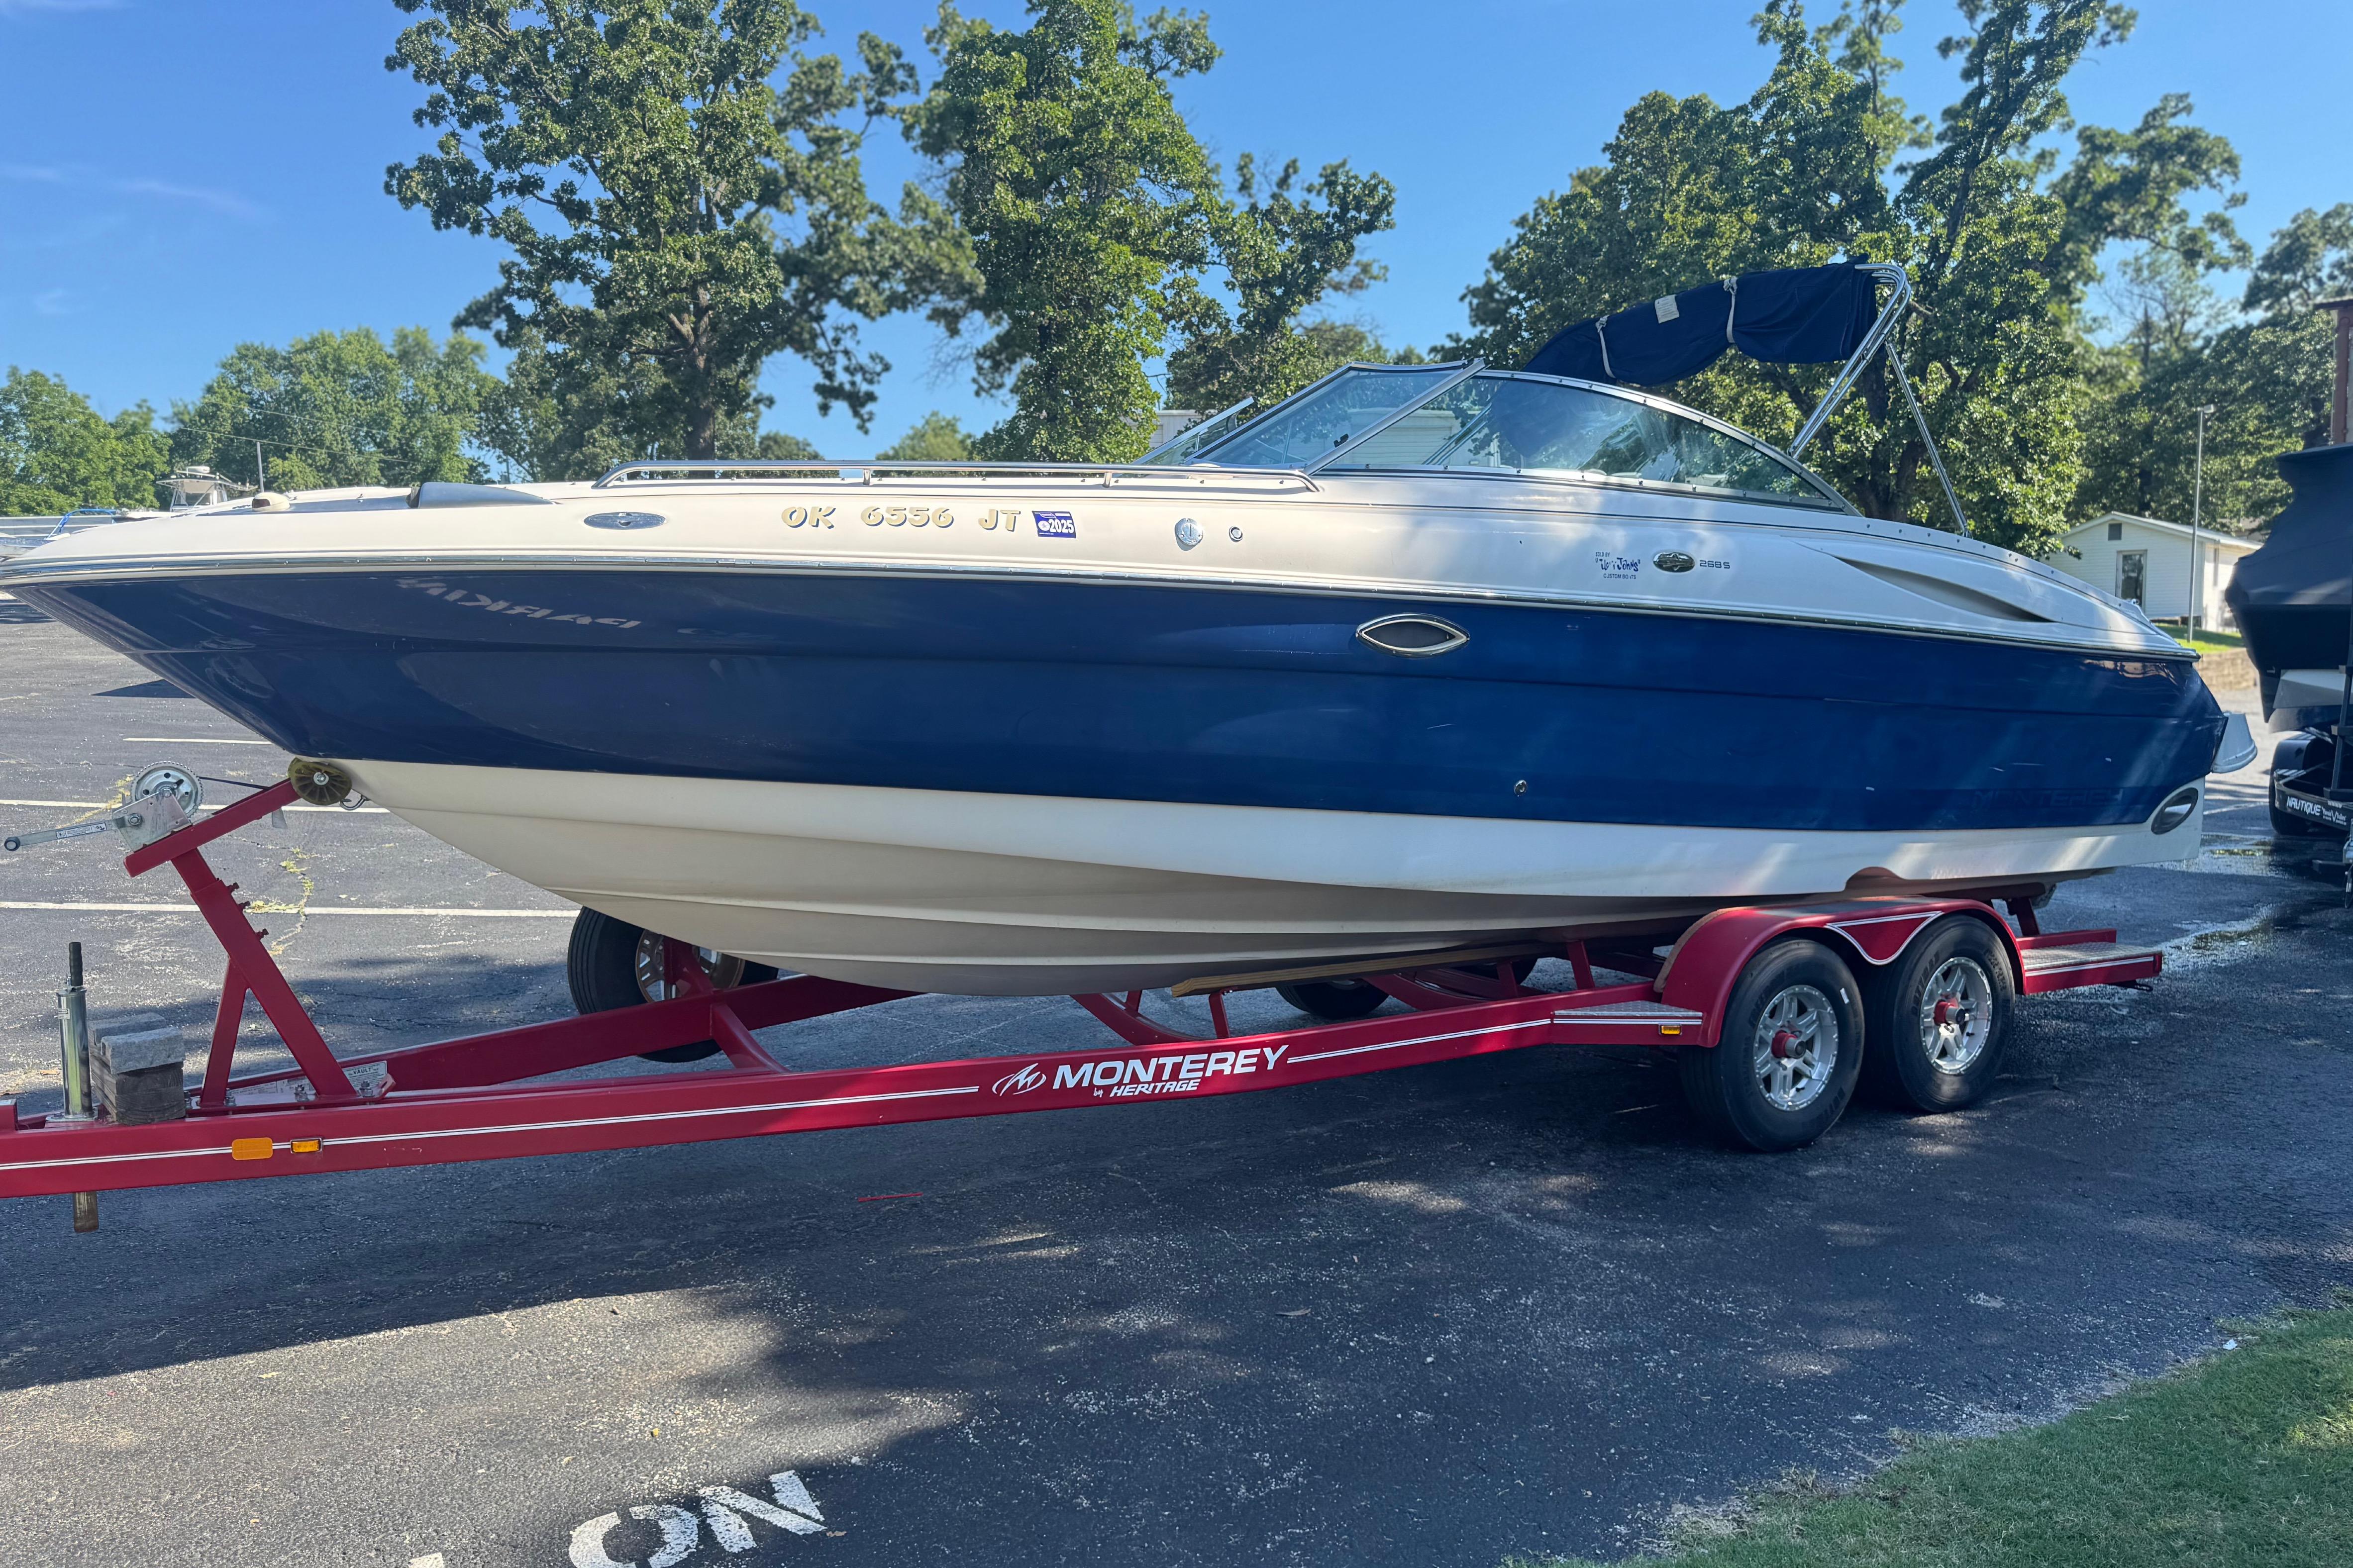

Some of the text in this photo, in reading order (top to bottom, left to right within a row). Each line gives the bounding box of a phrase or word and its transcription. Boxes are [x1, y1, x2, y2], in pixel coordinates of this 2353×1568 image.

[781, 506, 1021, 532] OK 6556 JT
[1048, 519, 1074, 533] 2025
[2287, 796, 2321, 816] NAUTIQUE
[1052, 1045, 1289, 1090] MONTEREY
[1093, 1079, 1201, 1097] by HERITAGE
